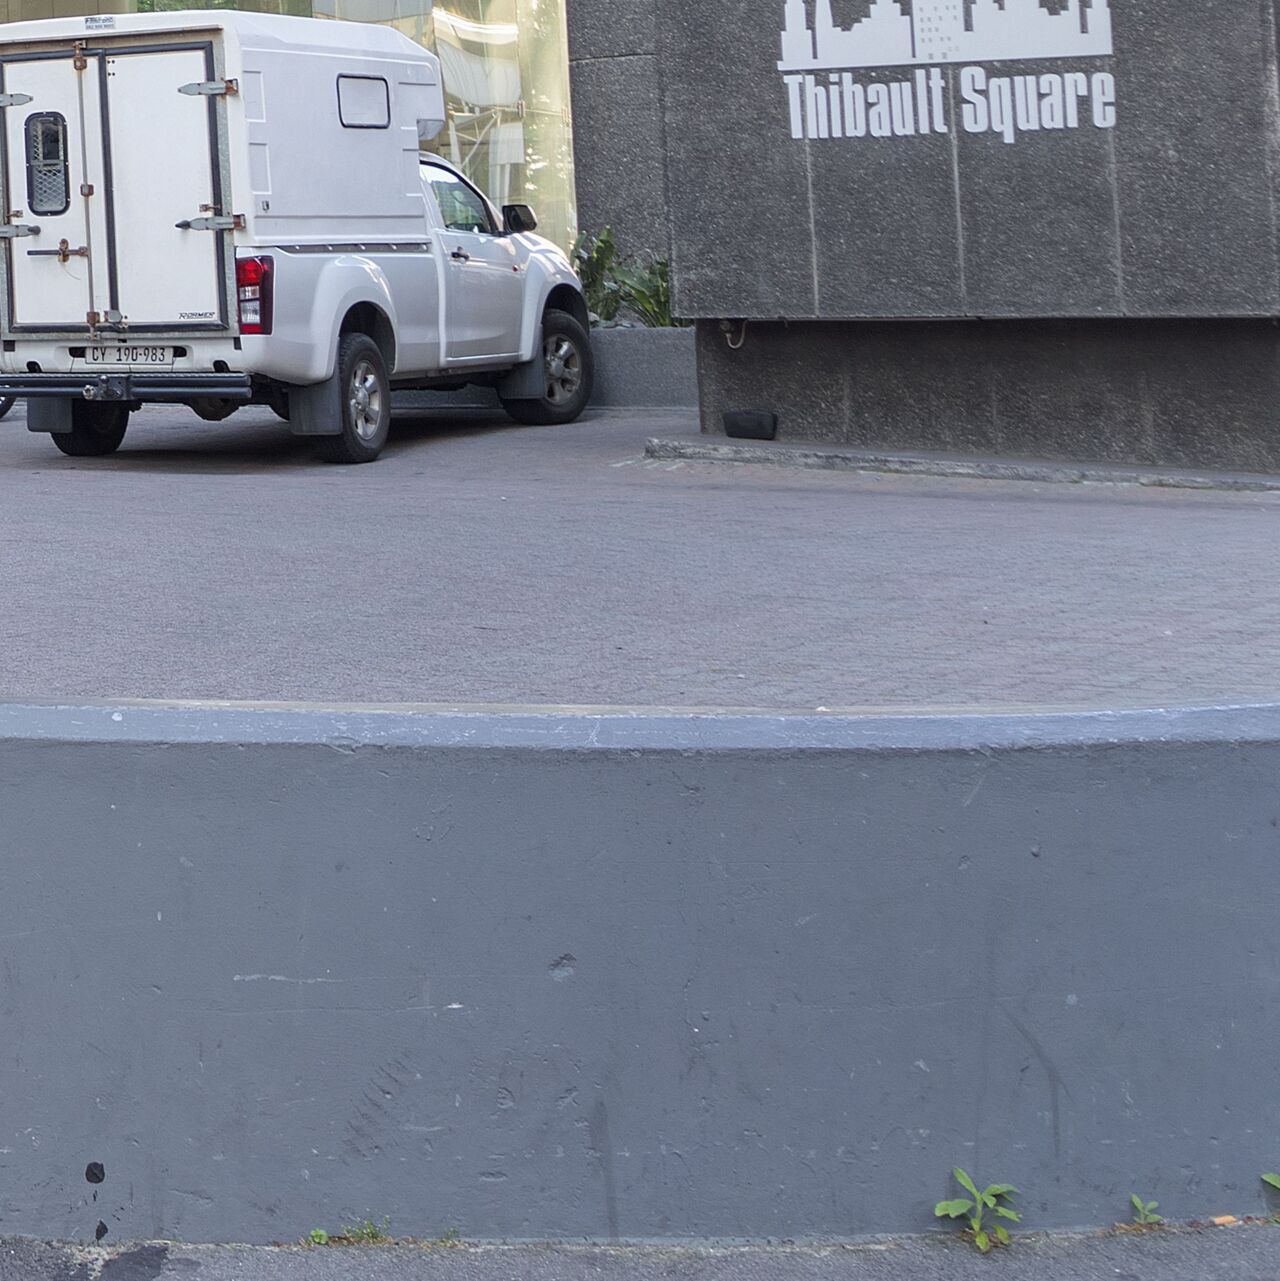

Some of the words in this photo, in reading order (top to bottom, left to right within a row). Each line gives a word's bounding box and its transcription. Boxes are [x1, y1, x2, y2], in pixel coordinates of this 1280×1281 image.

[783, 67, 949, 140] Thibault
[960, 66, 1117, 144] Square
[92, 347, 107, 361] CY
